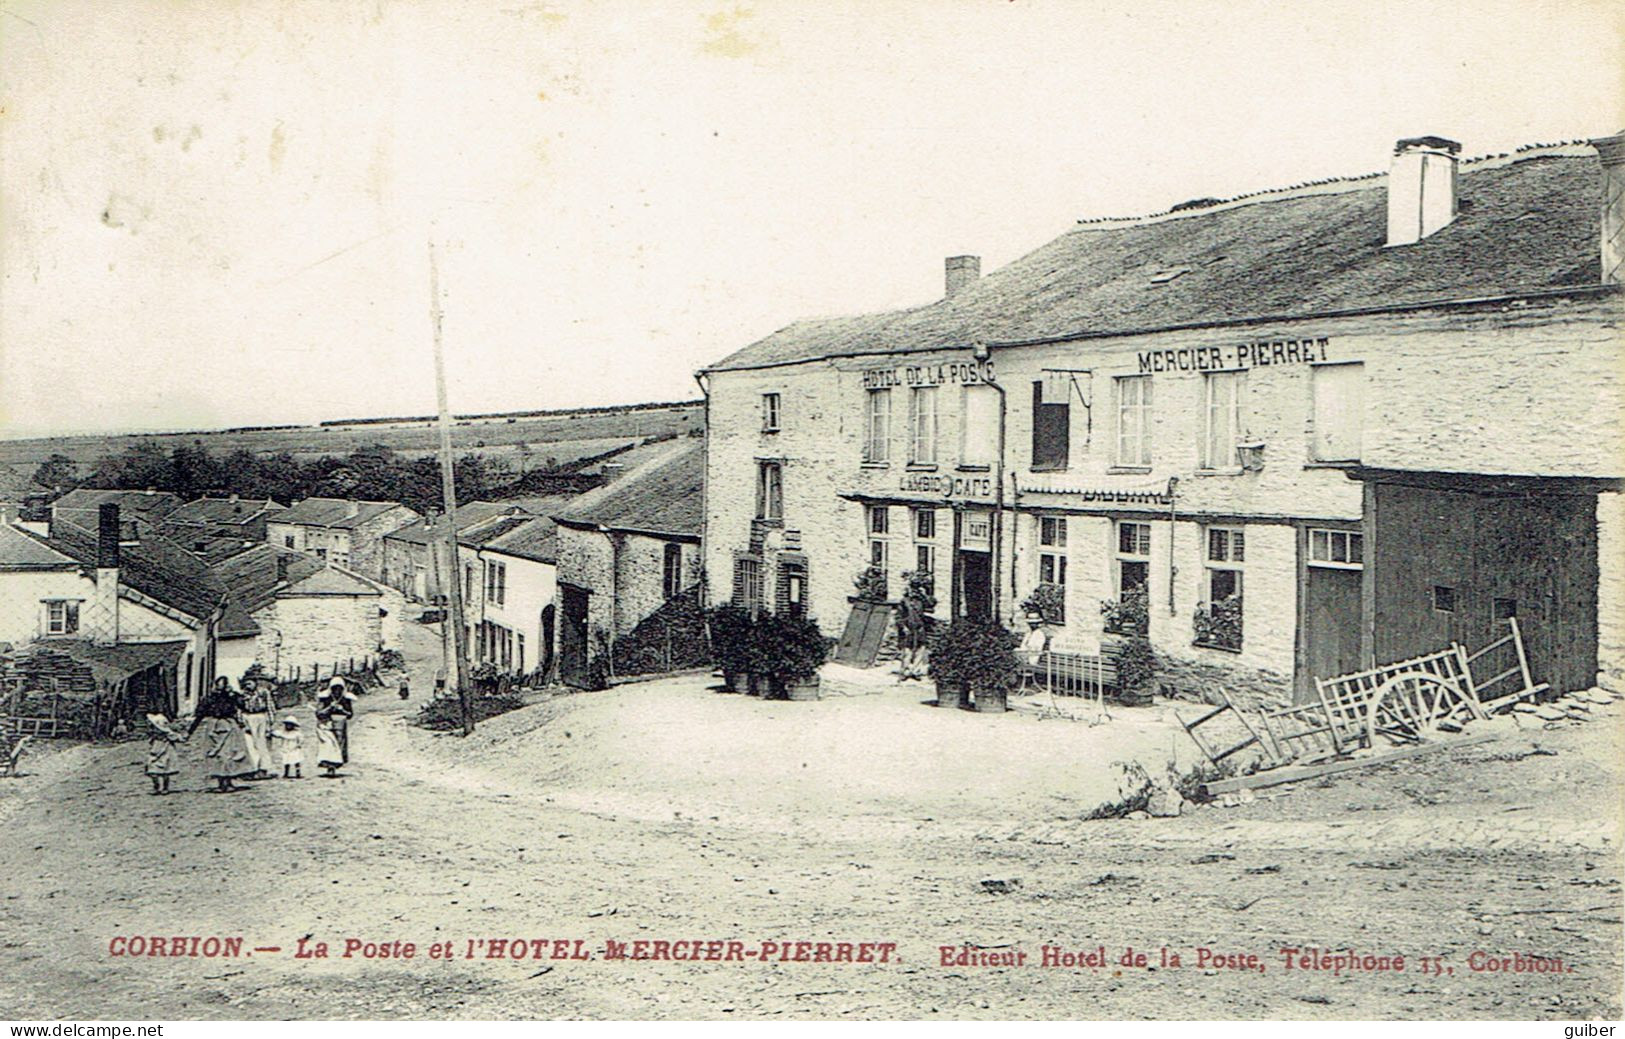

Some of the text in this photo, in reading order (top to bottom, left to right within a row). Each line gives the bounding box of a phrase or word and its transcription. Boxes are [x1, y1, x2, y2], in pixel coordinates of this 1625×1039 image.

[906, 367, 923, 385] DE
[928, 366, 945, 384] LA
[900, 476, 941, 492] LAMBIC
